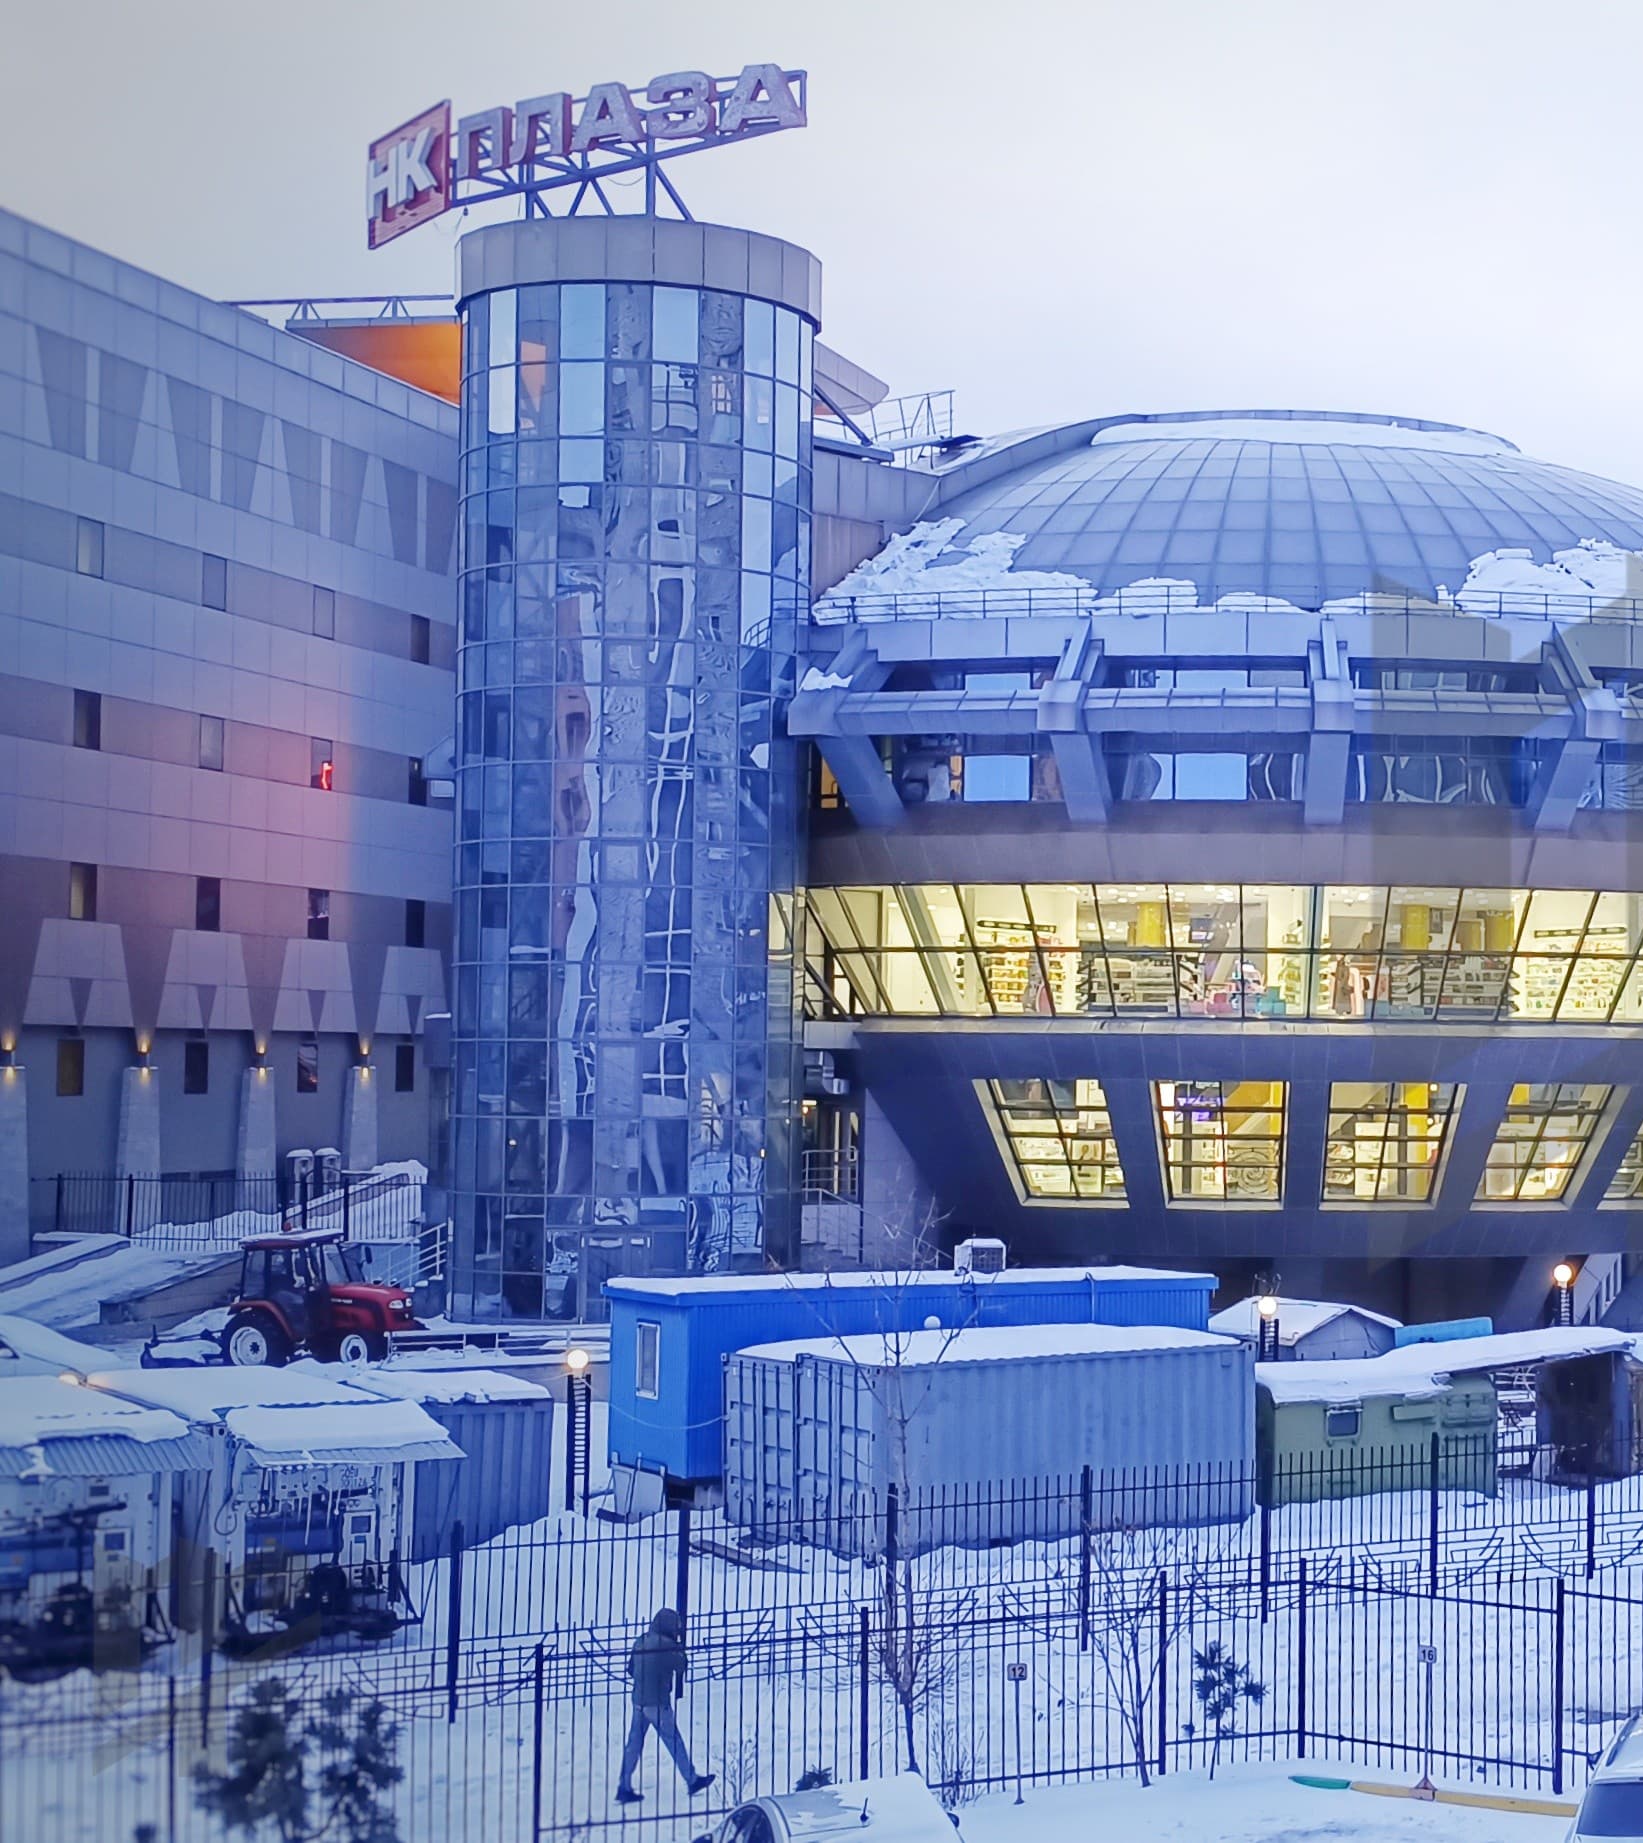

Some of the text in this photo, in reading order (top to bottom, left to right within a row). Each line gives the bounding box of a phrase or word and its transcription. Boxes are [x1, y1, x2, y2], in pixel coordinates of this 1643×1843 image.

[458, 63, 803, 178] ПЛАЗА
[1421, 1648, 1434, 1661] 16
[1011, 1666, 1025, 1678] 12
